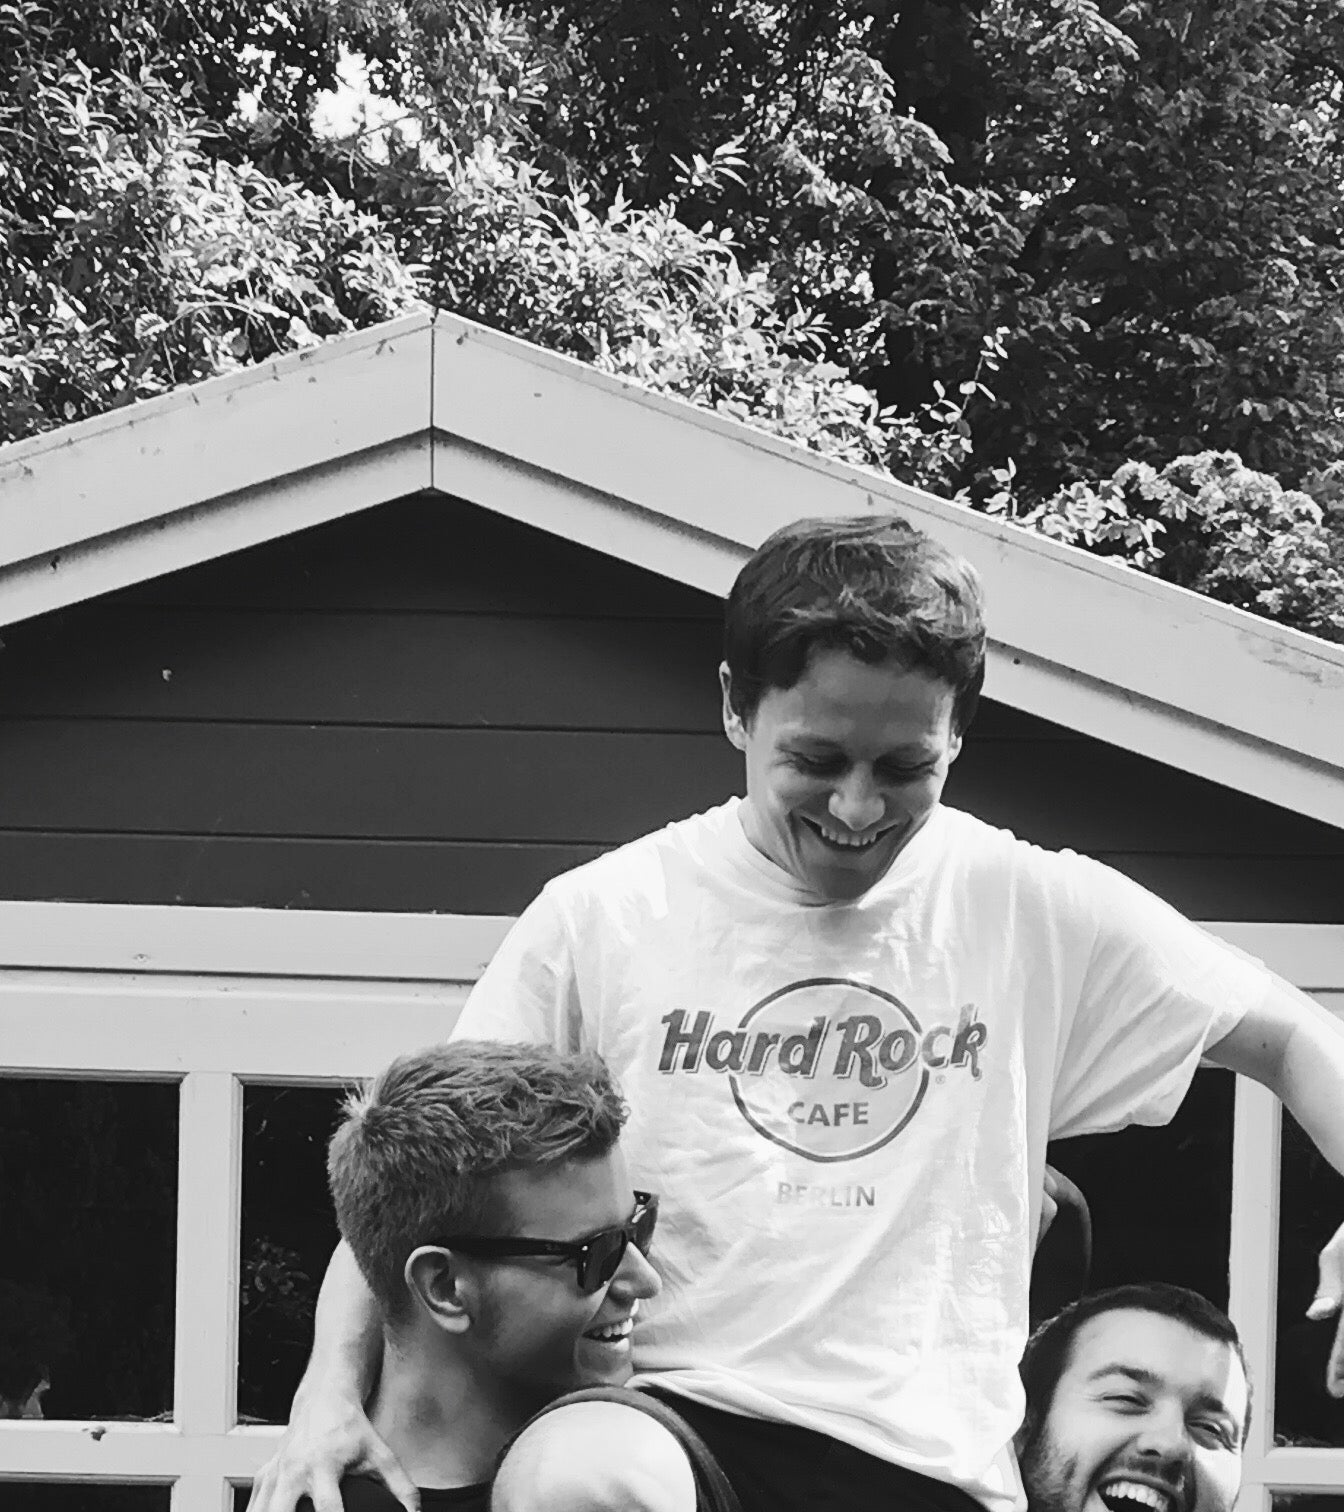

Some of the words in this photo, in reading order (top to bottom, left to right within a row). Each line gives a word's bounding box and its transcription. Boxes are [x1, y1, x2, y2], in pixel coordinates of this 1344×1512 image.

[657, 1008, 831, 1079] Hard
[832, 1002, 989, 1089] Rock
[787, 1100, 870, 1127] CAFE
[776, 1181, 876, 1207] BERLIN
